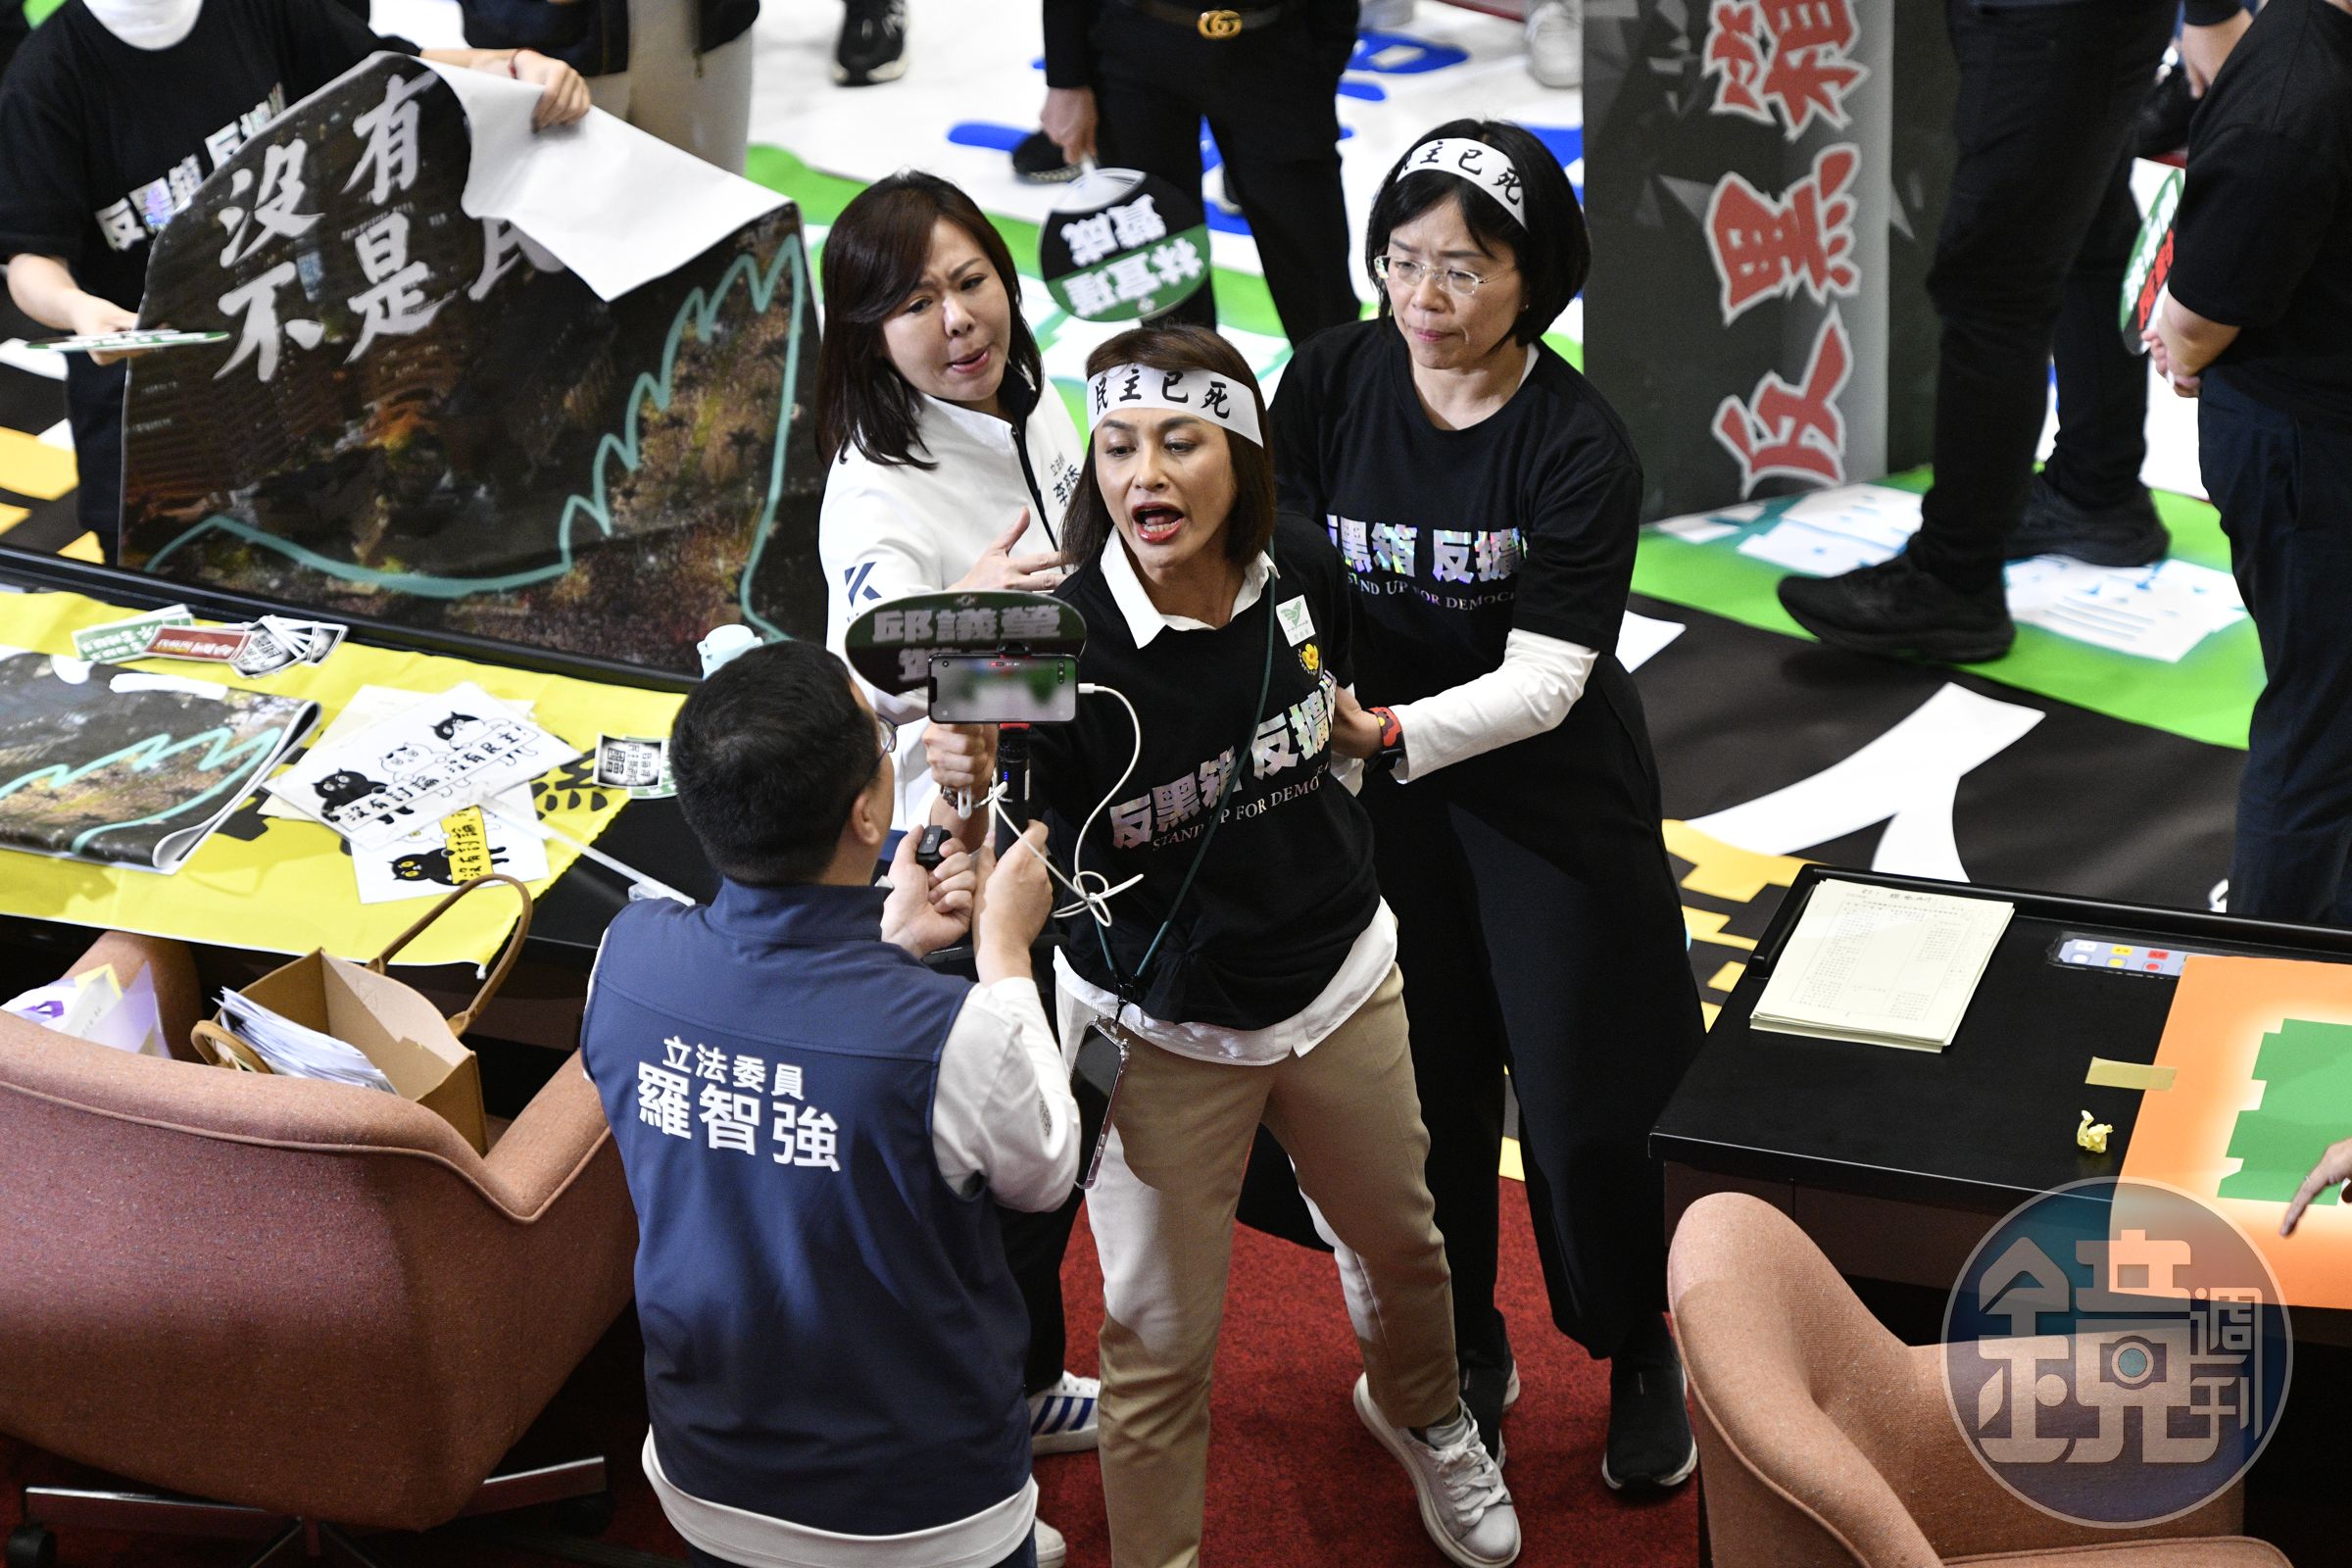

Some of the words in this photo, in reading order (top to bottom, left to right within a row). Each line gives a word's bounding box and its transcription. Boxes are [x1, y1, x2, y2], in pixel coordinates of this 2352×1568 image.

[1403, 141, 1520, 206] 主已死
[1095, 368, 1231, 419] 民主已死
[1431, 526, 1528, 585] 反擴
[1386, 579, 1409, 595] UP
[872, 604, 1061, 643] 邱議瑩
[1109, 745, 1243, 850] 反黑箱
[1235, 798, 1268, 821] FOR
[662, 1035, 806, 1102] 立法委員
[637, 1060, 842, 1173] 羅智強
